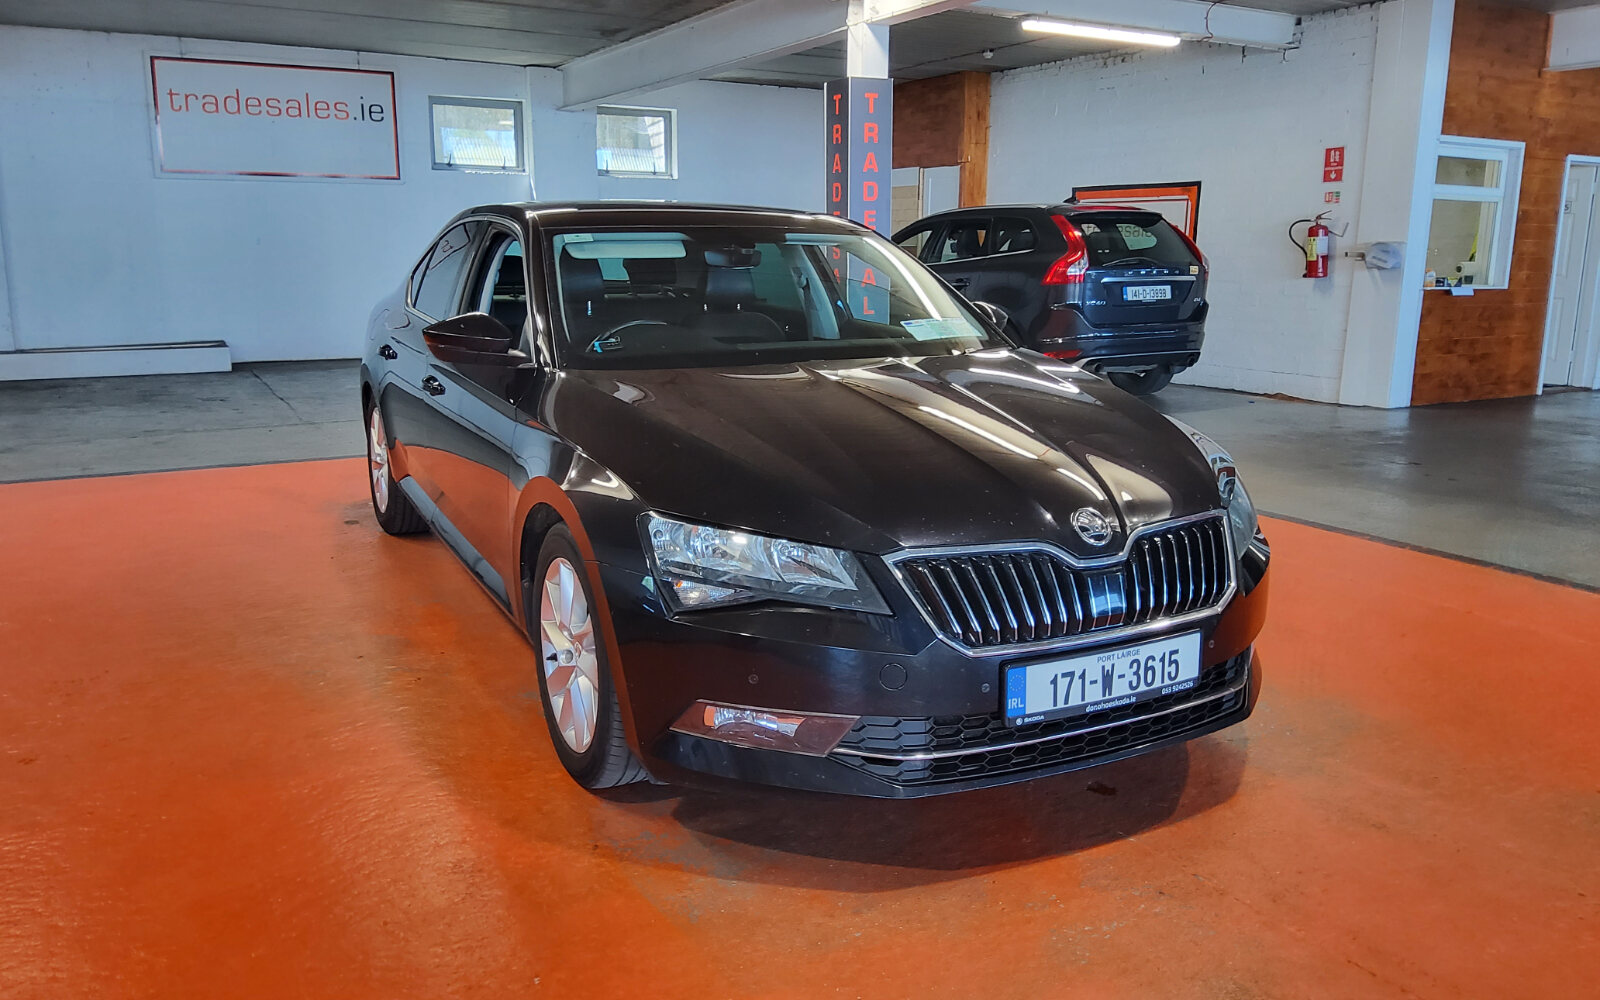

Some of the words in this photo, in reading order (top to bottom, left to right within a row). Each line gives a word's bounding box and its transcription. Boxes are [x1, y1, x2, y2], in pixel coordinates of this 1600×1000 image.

[167, 88, 385, 122] tradesales.ie
[1097, 653, 1115, 664] PORT
[1049, 648, 1180, 708] 171-W-3615
[1007, 697, 1025, 710] IRL
